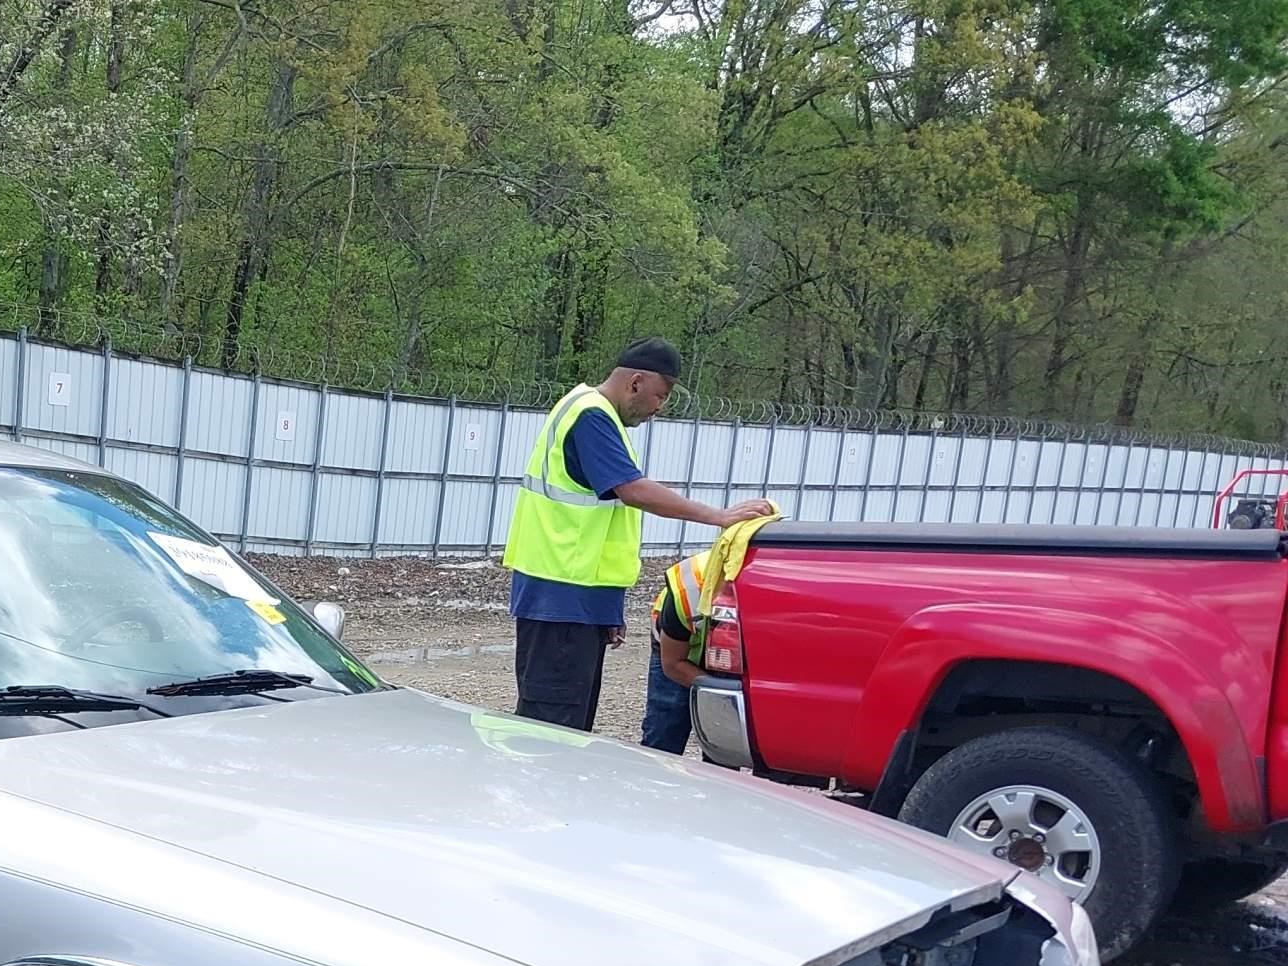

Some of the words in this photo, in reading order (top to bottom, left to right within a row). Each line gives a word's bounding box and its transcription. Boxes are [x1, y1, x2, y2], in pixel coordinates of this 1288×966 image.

[56, 383, 63, 394] 7
[283, 420, 289, 430] 8
[469, 431, 476, 441] 9
